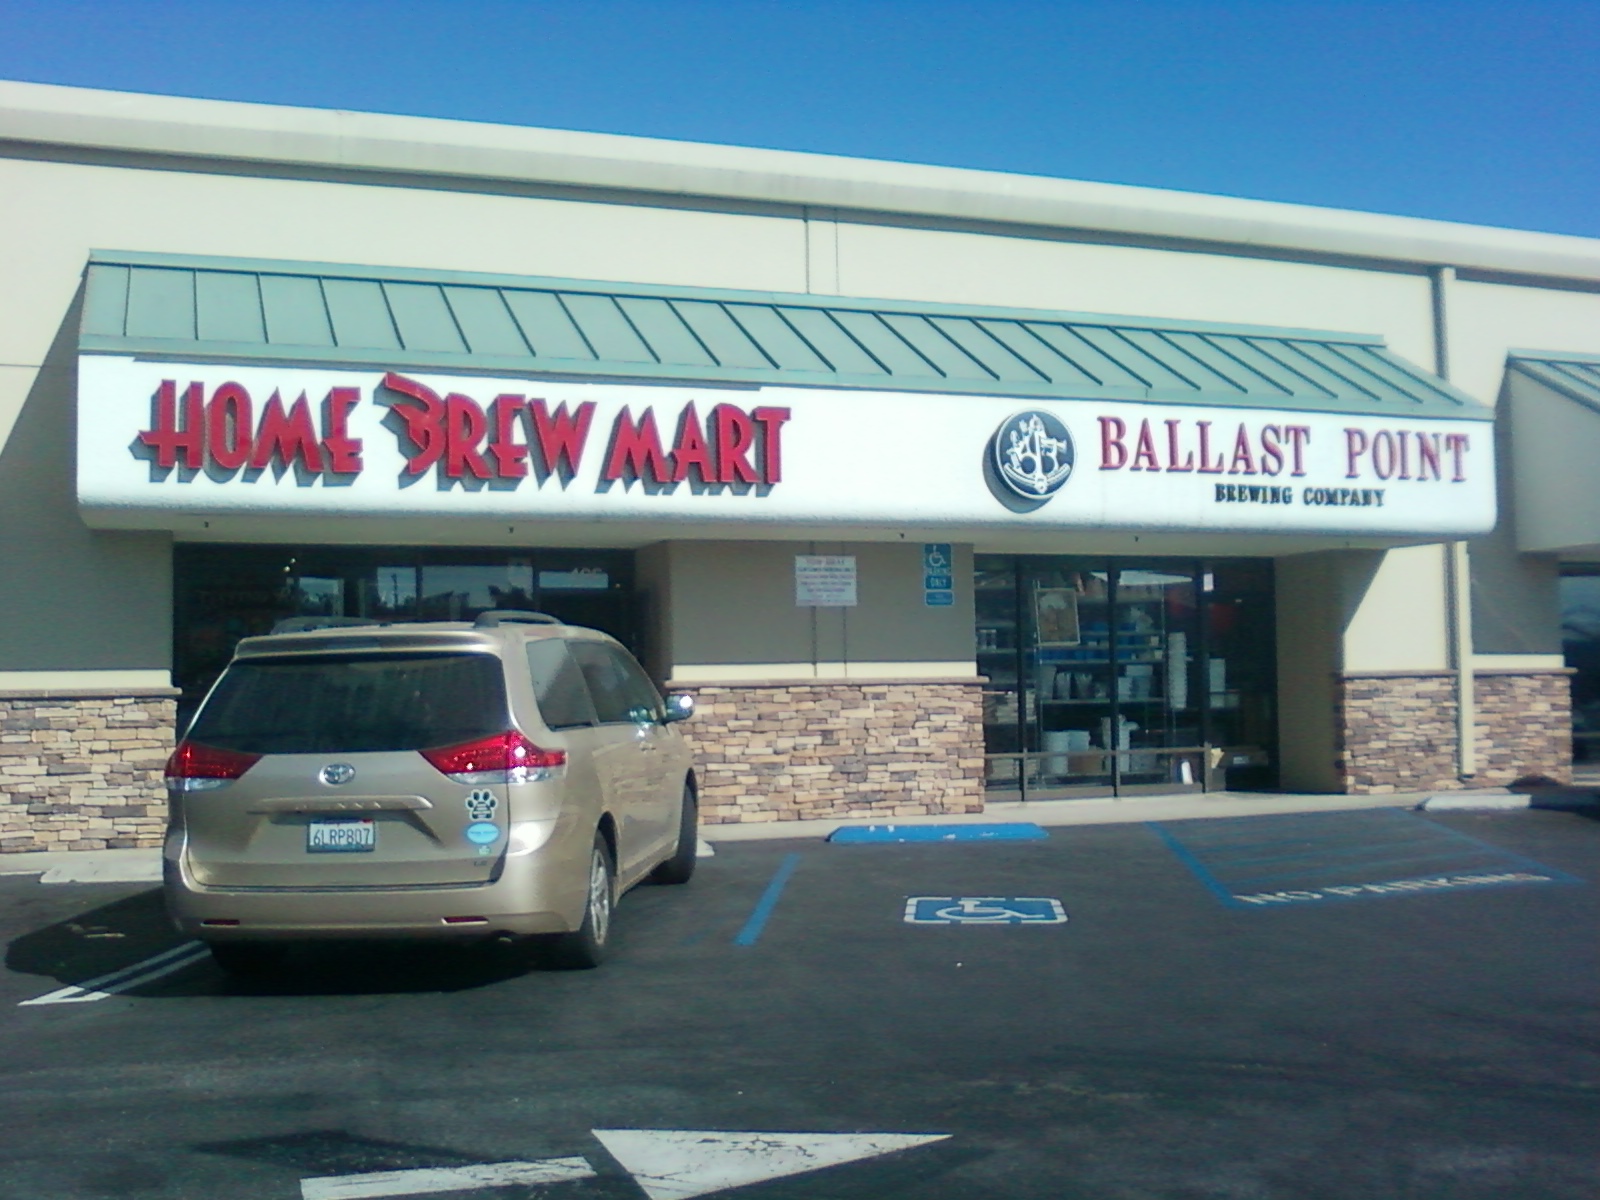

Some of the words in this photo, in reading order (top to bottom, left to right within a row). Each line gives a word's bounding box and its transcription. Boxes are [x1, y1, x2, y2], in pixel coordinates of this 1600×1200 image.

[132, 378, 364, 476] HOME
[605, 399, 791, 488] MART
[1097, 415, 1311, 478] BALLAST
[1343, 427, 1470, 482] POINT
[1214, 483, 1293, 504] BREWING
[1303, 487, 1386, 507] COMPANY
[313, 827, 371, 845] 6LRP807
